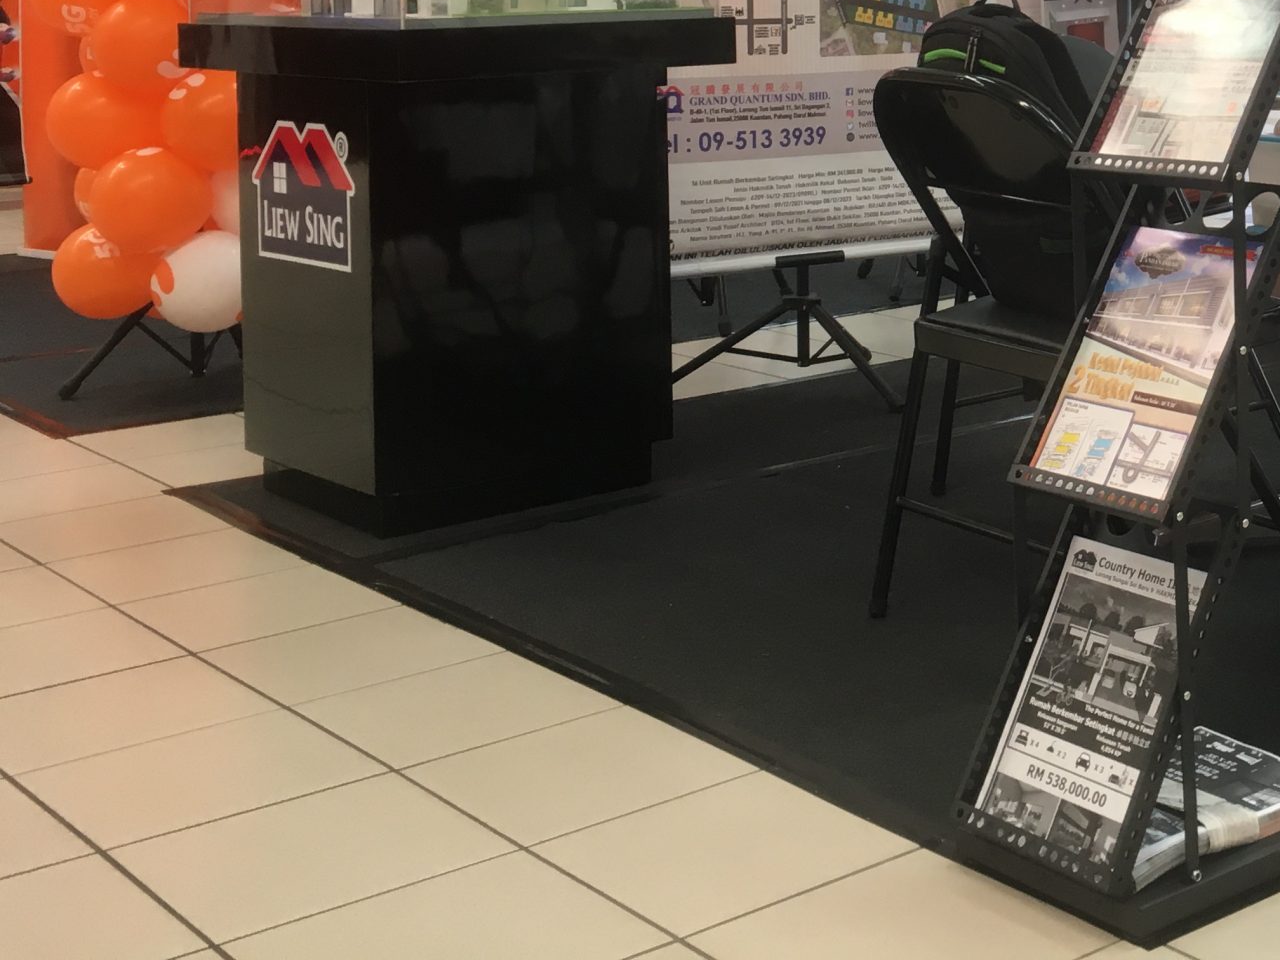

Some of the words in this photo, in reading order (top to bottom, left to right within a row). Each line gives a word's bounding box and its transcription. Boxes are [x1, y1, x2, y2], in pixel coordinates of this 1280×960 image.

[689, 95, 728, 106] GRAND
[729, 94, 783, 106] QUANTUM
[784, 93, 807, 103] SDN.
[808, 91, 831, 101] BHD.
[698, 129, 773, 152] 09-513
[779, 125, 826, 147] 3939
[263, 199, 300, 241] LIEW
[305, 205, 345, 249] SING
[1098, 556, 1137, 579] Country
[1137, 567, 1166, 587] Home
[1028, 695, 1052, 712] Rumah
[1050, 702, 1085, 724] Berkembar
[1084, 717, 1116, 737] Setingkat
[1026, 763, 1046, 783] RM
[1045, 771, 1108, 808] 538,000.00
